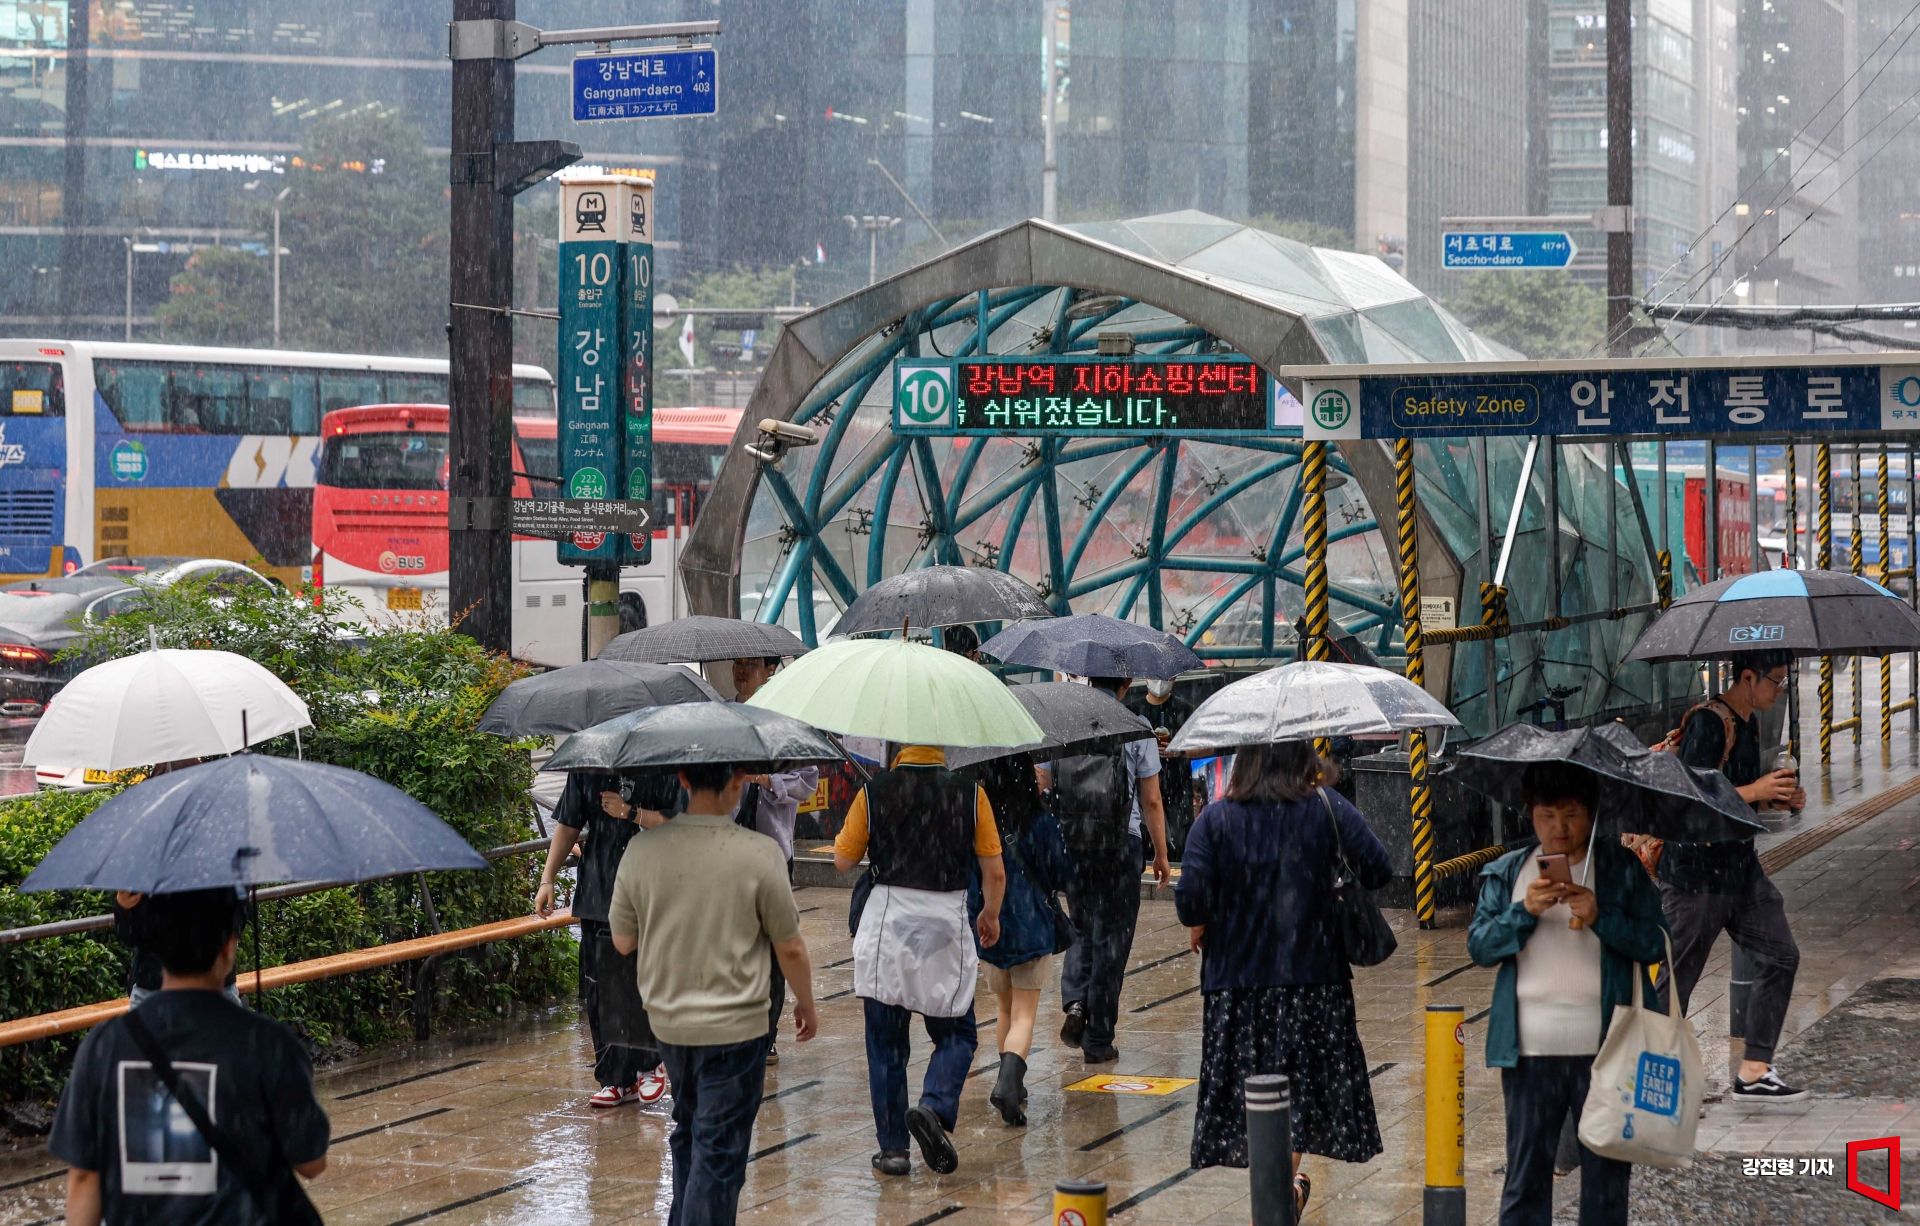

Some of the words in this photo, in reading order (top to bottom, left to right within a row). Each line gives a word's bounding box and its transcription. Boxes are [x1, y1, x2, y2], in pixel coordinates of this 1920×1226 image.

[698, 56, 703, 65] 1
[599, 59, 667, 81] 강남대로
[584, 84, 682, 100] Gangnam-daero
[693, 82, 710, 93] 403
[588, 105, 624, 116] 江南大路
[632, 103, 678, 114] カンナムデロ
[586, 198, 597, 208] M
[1448, 236, 1514, 251] 서초대로
[1448, 254, 1524, 265] Seocho-daero
[575, 253, 611, 286] 10
[631, 254, 650, 288] 10
[577, 289, 603, 300] 출입구
[575, 328, 605, 411] 강남
[631, 330, 648, 412] 강남
[968, 365, 1055, 393] 강남역
[1073, 364, 1257, 393] 지하쇼핑센터
[905, 380, 946, 414] 10
[984, 397, 1178, 426] 쉬워졌습니다.
[1404, 397, 1466, 416] Safety
[1476, 395, 1526, 414] Zone
[568, 420, 609, 432] Gangnam
[580, 434, 598, 444] 江南
[573, 448, 604, 457] カンナム
[581, 475, 597, 483] 222
[575, 485, 603, 499] 2호선
[1890, 490, 1907, 503] 14
[513, 500, 535, 513] 강남역
[536, 501, 565, 514] 고기골목
[583, 502, 627, 515] 음식문화거리
[398, 556, 425, 570] BUS
[1643, 1060, 1675, 1080] KEEP
[1642, 1074, 1673, 1096] EARTH
[1640, 1088, 1672, 1110] FRESH
